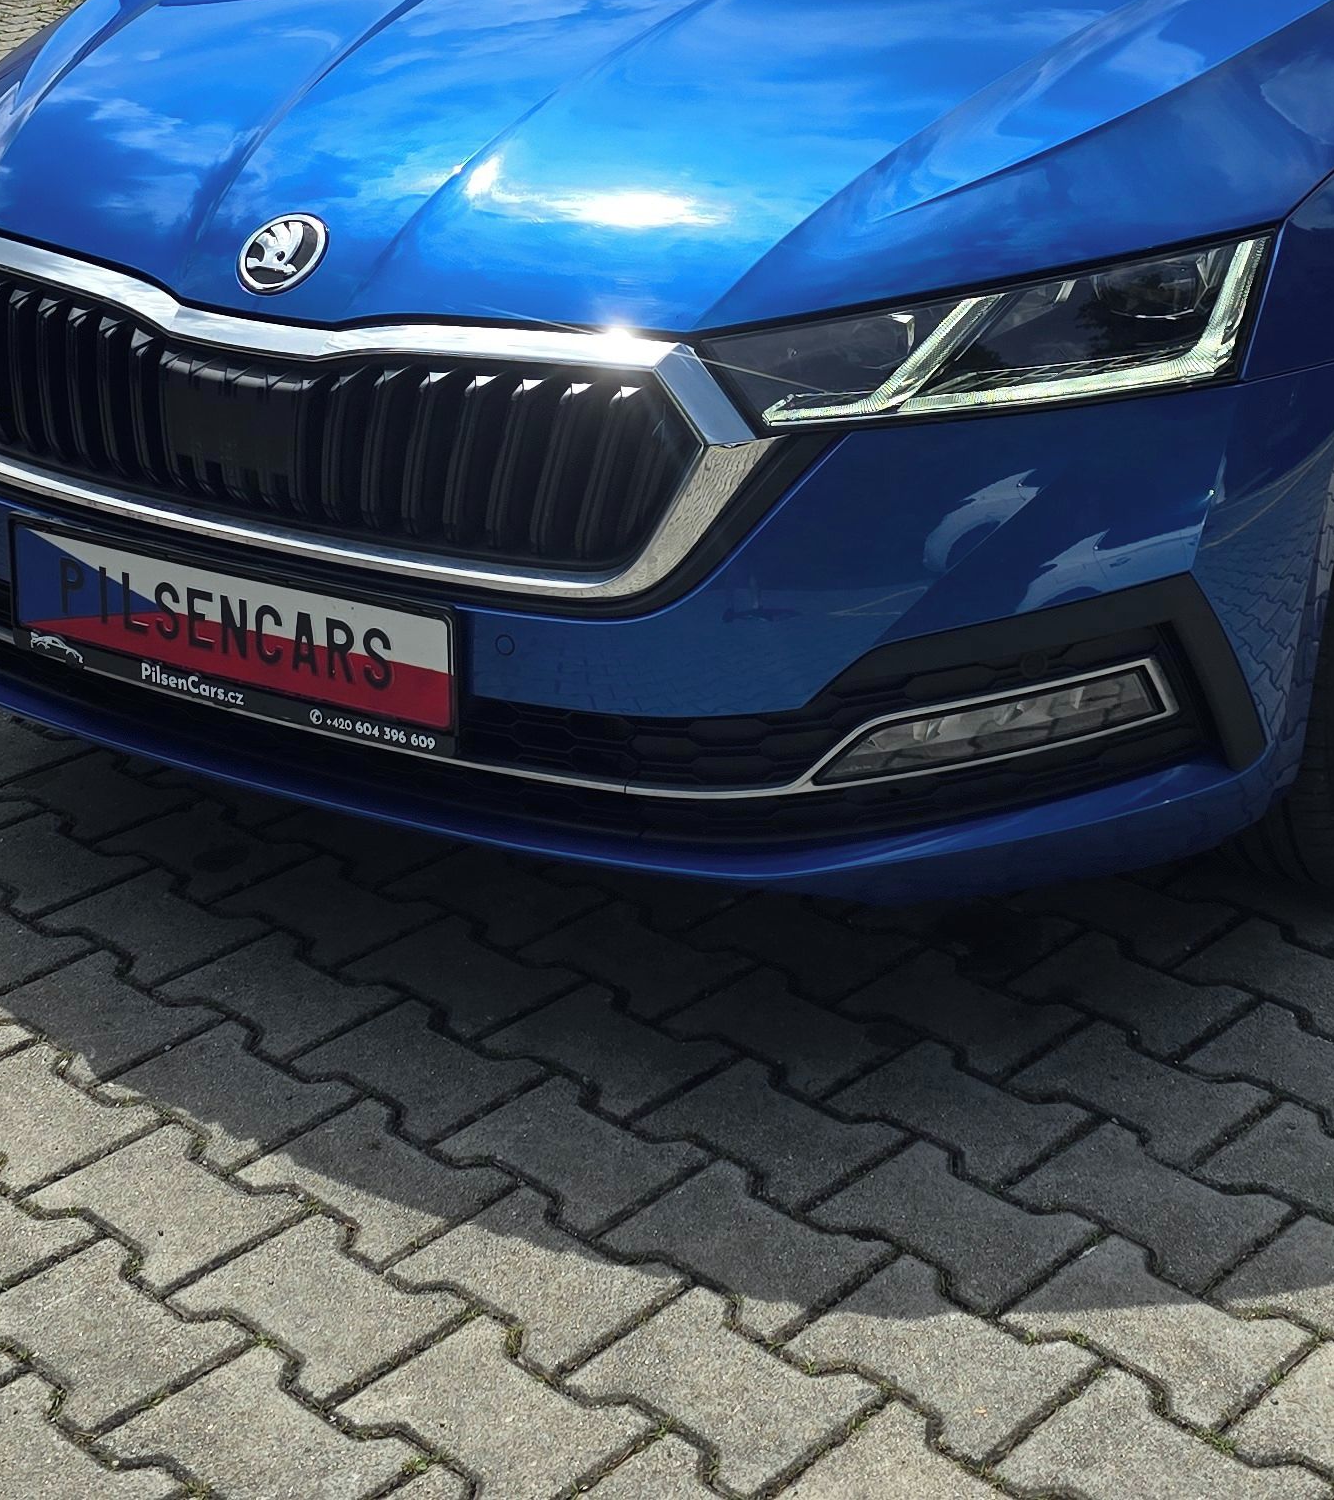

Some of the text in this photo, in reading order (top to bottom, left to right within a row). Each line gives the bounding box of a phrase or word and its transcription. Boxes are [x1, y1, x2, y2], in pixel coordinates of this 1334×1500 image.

[59, 556, 394, 688] PILSENCARS
[141, 662, 245, 706] PilsenCars.cz
[326, 717, 436, 750] +420 604 396 609
